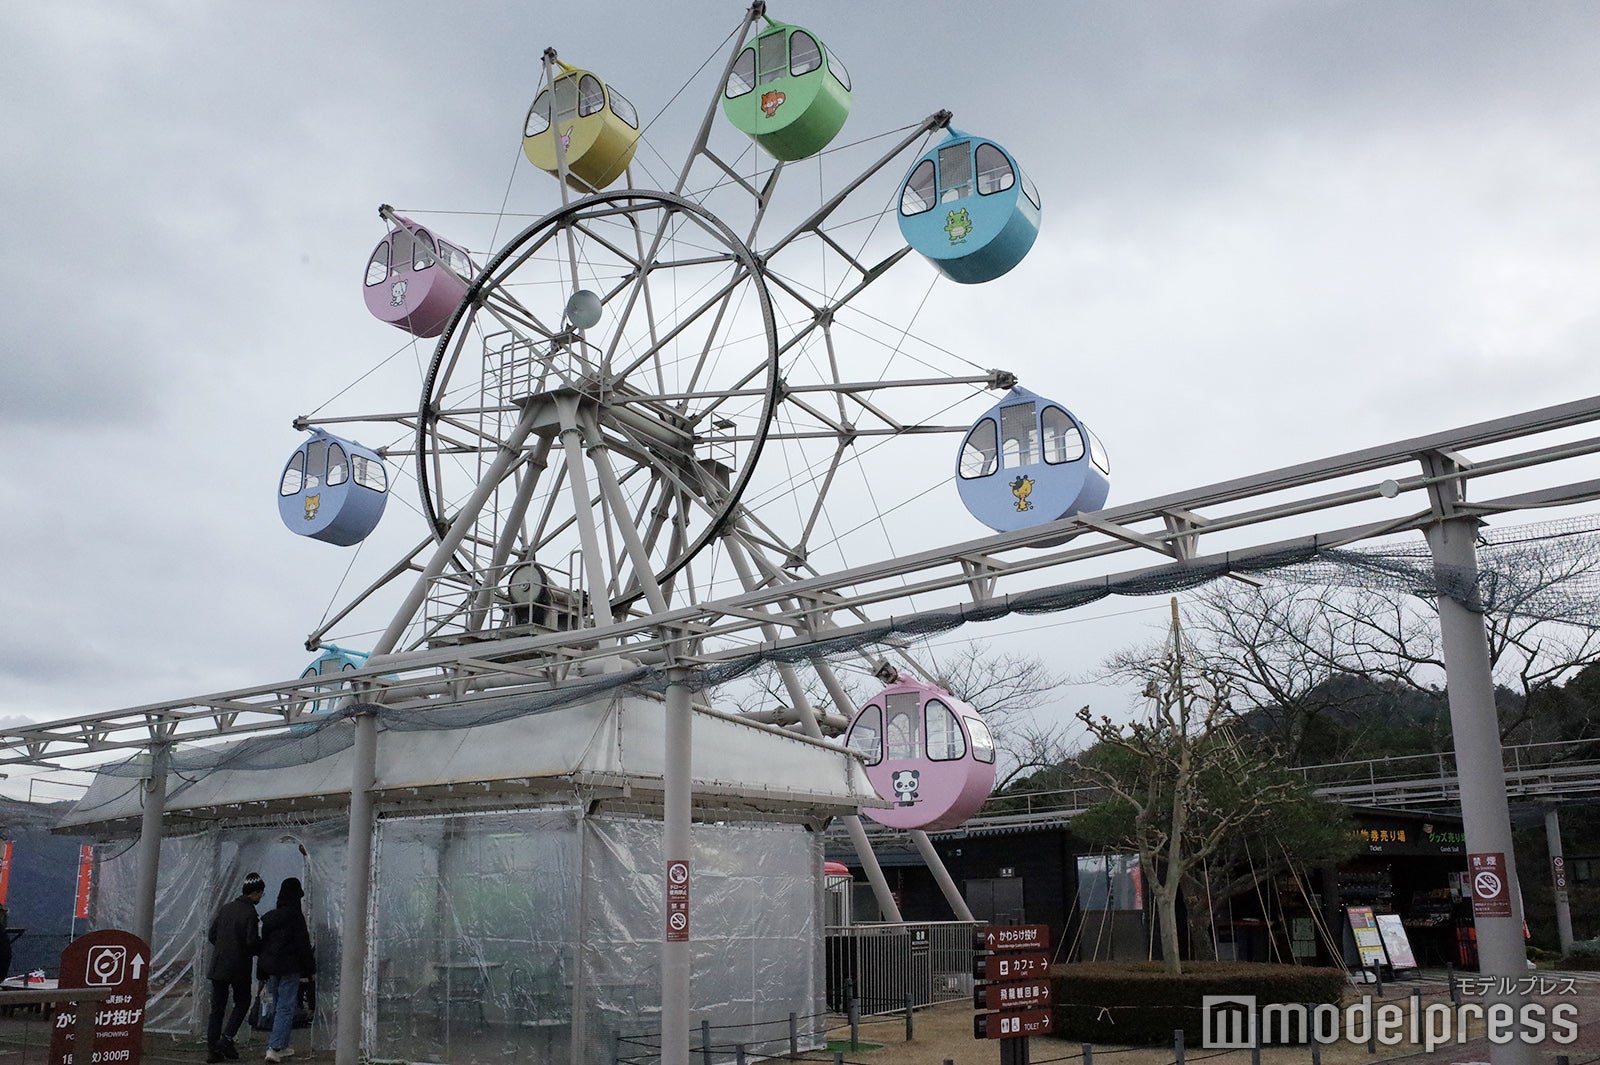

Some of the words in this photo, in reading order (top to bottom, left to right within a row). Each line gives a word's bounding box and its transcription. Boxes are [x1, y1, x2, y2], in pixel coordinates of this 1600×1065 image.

[999, 929, 1037, 941] かわらけ投げ
[1013, 959, 1034, 970] カフェ
